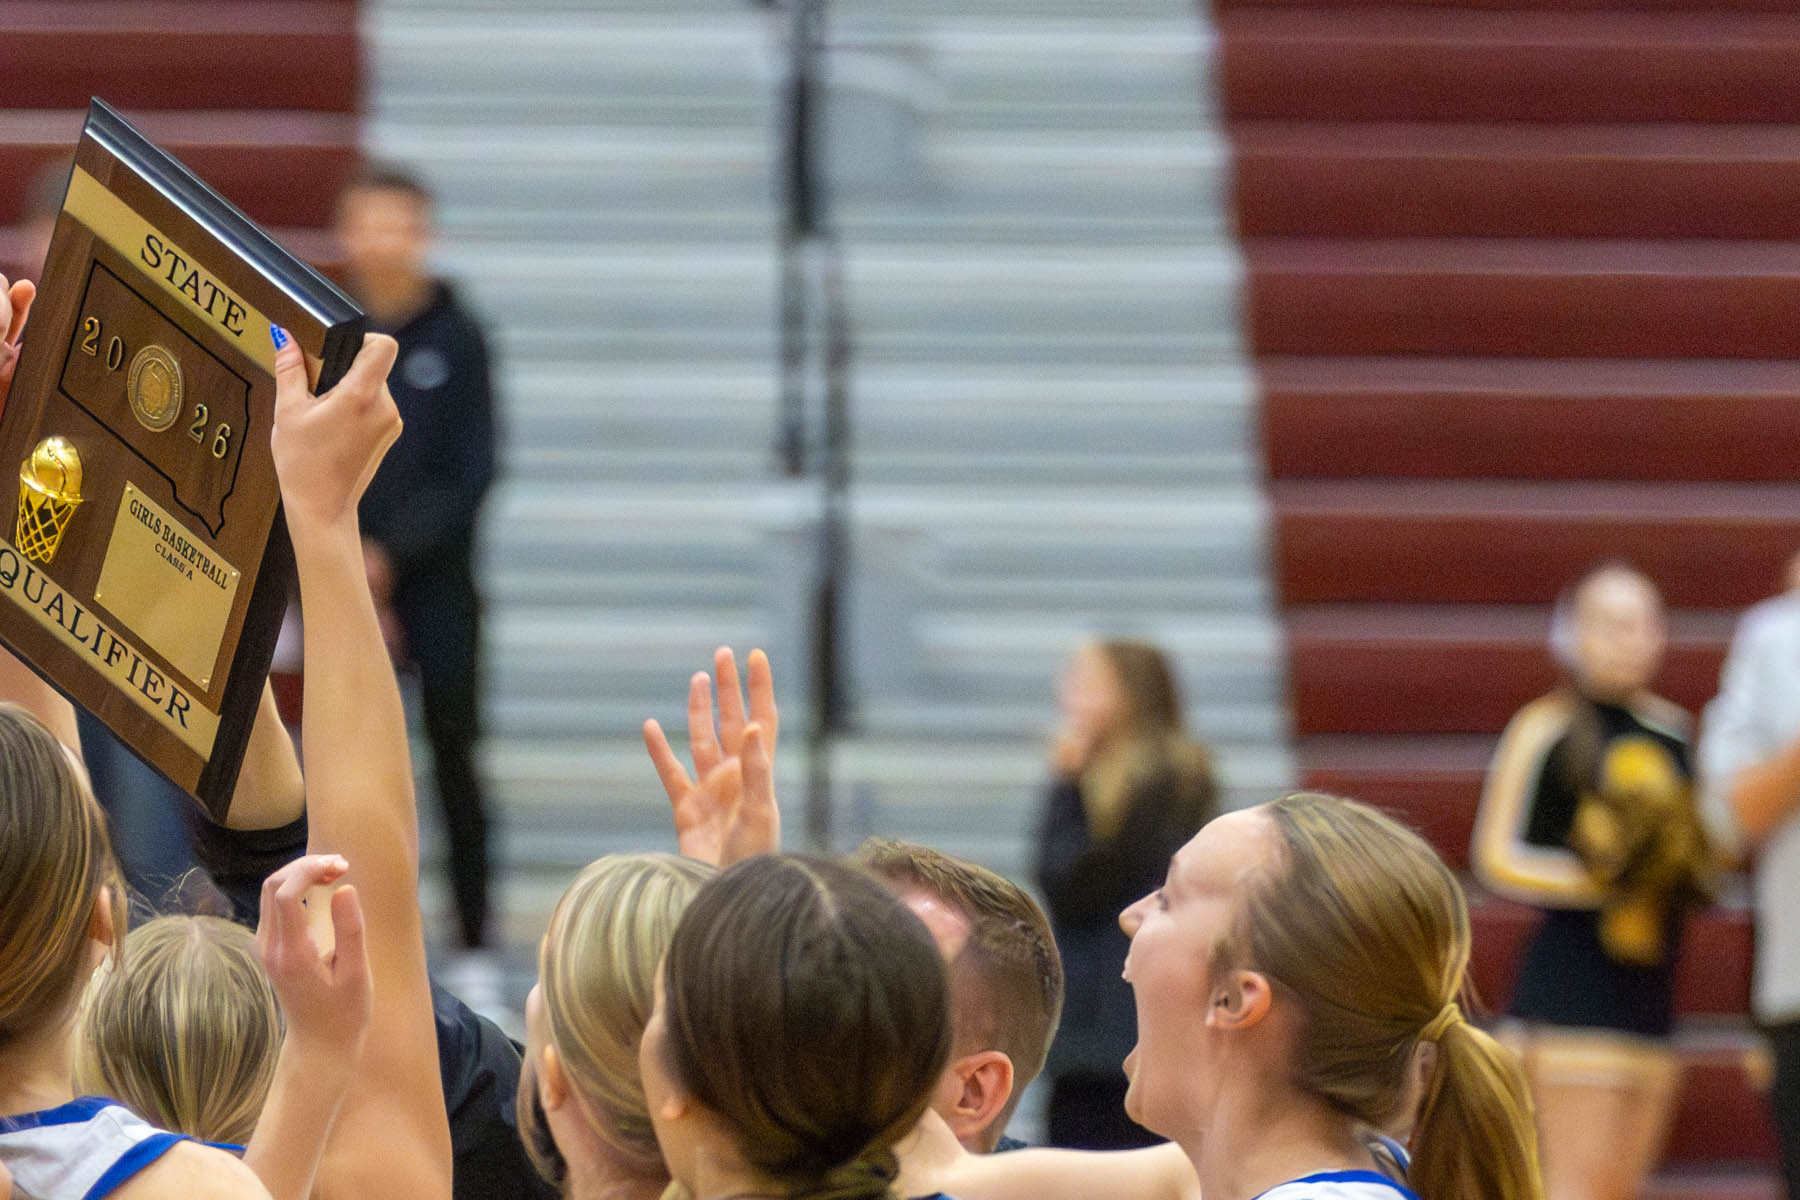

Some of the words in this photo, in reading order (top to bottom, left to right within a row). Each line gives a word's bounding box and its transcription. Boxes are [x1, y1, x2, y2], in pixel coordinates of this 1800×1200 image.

[141, 234, 246, 336] STATE
[129, 499, 161, 534] GIRLS
[161, 525, 227, 590] BASKETBALL
[155, 543, 185, 573] CLASS
[186, 570, 193, 581] A
